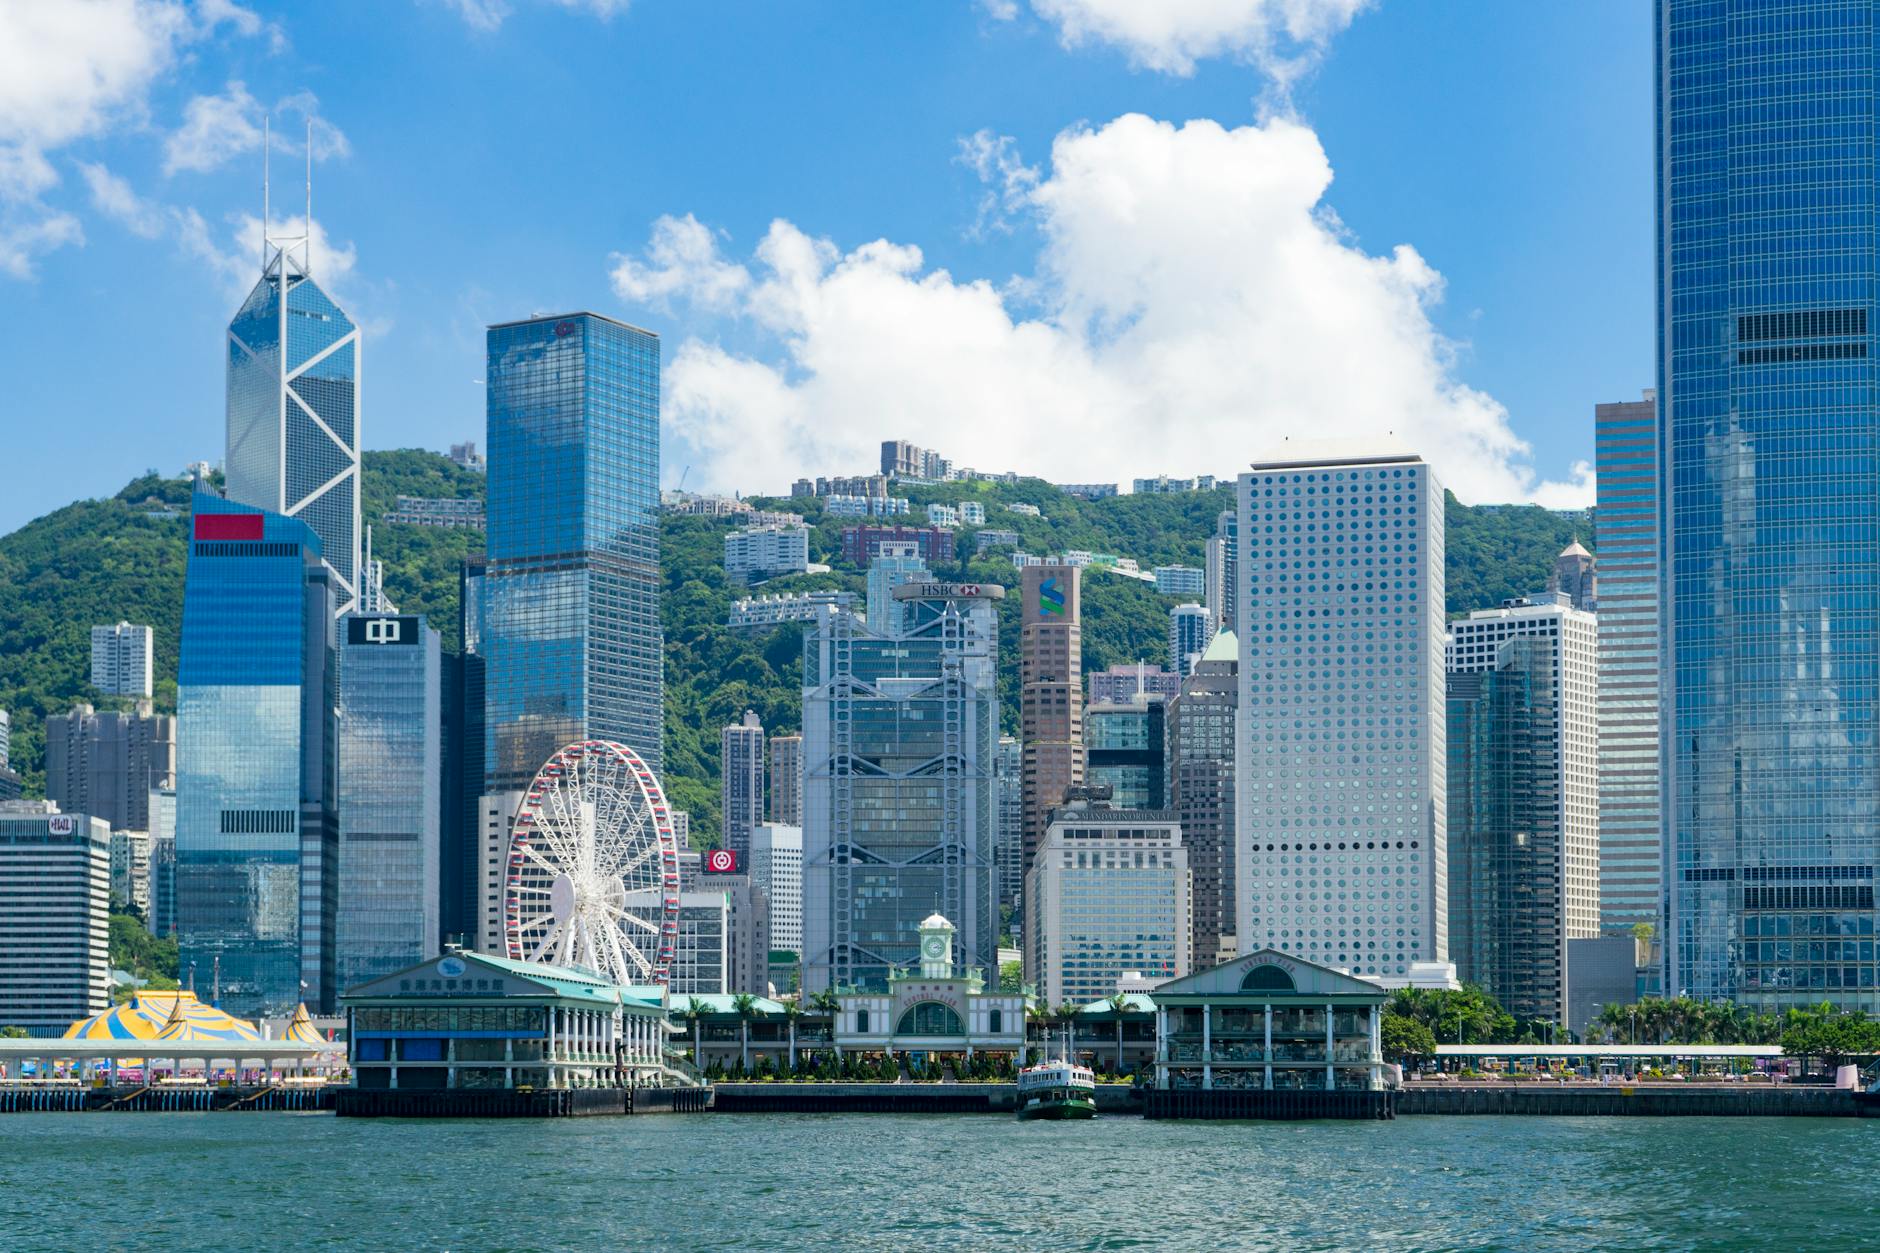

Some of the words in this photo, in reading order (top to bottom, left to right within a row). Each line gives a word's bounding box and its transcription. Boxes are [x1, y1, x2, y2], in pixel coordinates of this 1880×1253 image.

[922, 585, 958, 596] HSBC
[1082, 812, 1128, 821] MANDARIN
[1129, 812, 1170, 821] ORIENTAL
